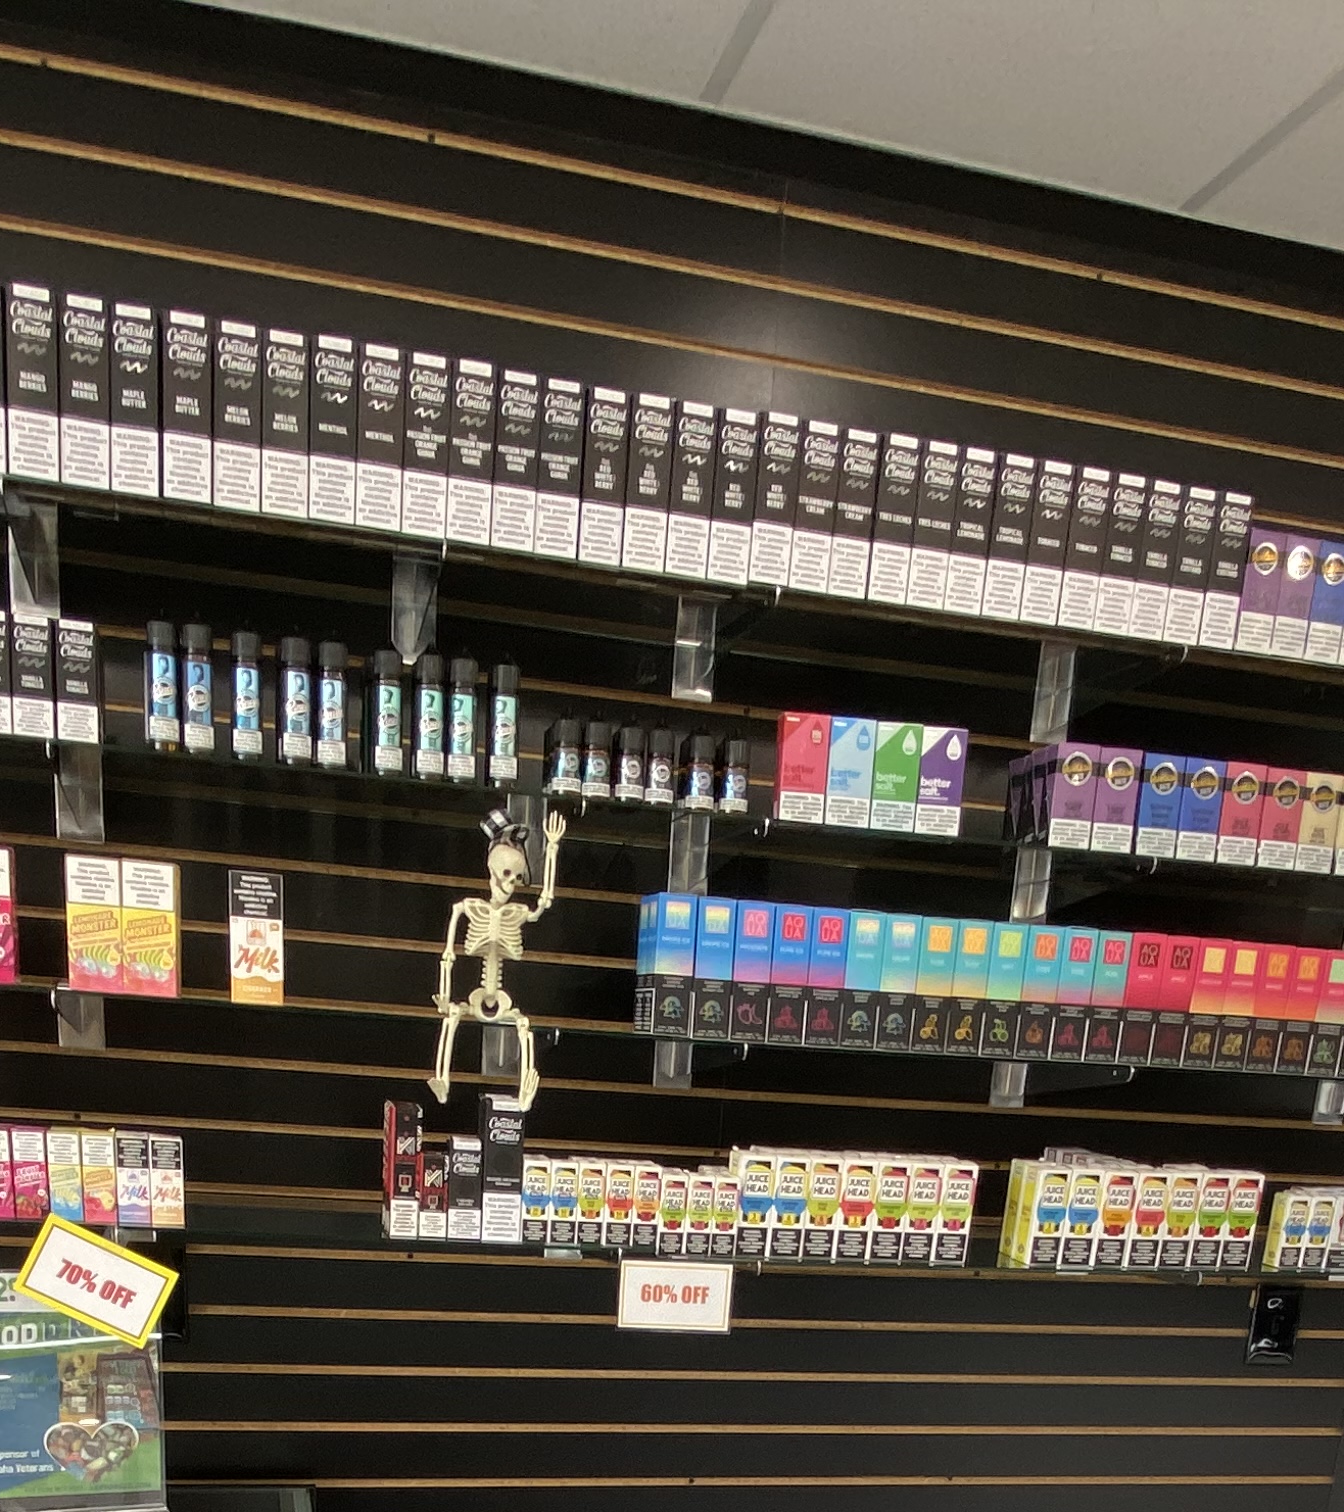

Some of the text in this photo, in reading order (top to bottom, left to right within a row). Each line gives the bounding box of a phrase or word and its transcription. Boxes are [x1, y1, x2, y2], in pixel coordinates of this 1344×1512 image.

[877, 772, 906, 784] better
[921, 777, 951, 790] better
[70, 919, 118, 935] MONSTER
[124, 924, 172, 939] MONSTER
[234, 947, 280, 974] Milk
[489, 1117, 522, 1129] Coastal
[490, 1129, 520, 1141] Clouds
[747, 1175, 769, 1183] JUICE
[782, 1176, 802, 1185] JUICE
[849, 1179, 870, 1187] JUICE
[746, 1184, 769, 1193] HEAD
[882, 1180, 904, 1189] JUICE
[949, 1183, 970, 1191] JUICE
[119, 1185, 149, 1200] Milk
[153, 1185, 182, 1200] Milk
[782, 1186, 802, 1194] HEAD
[848, 1188, 869, 1197] HEAD
[882, 1189, 904, 1198] HEAD
[1076, 1188, 1096, 1196] JUICE
[1110, 1189, 1130, 1197] JUICE
[947, 1192, 968, 1200] HEAD
[1207, 1191, 1226, 1199] JUICE
[1075, 1197, 1095, 1205] HEAD
[1109, 1198, 1129, 1206] HEAD
[1205, 1200, 1224, 1208] HEAD
[56, 1258, 137, 1309] 70% OFF
[640, 1284, 710, 1305] 60% OFF
